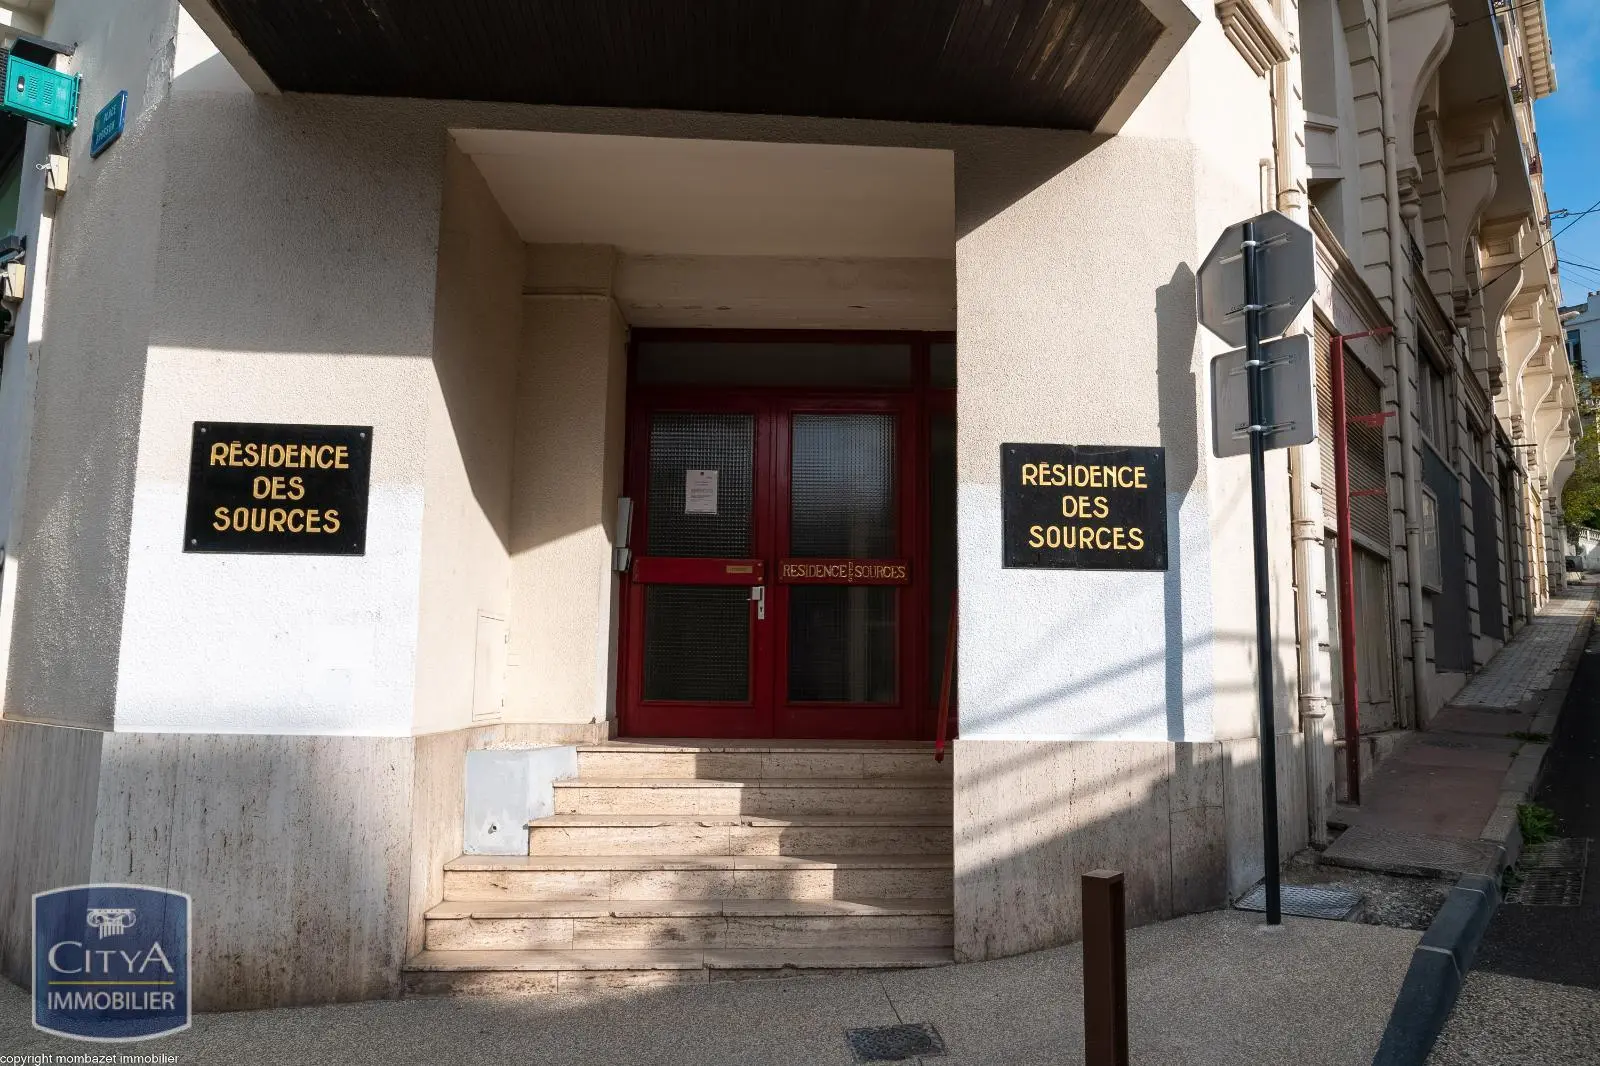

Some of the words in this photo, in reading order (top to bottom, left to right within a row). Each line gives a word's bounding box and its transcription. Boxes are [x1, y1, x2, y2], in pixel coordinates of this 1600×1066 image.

[209, 440, 350, 469] RÉSIDENCE
[252, 475, 306, 501] DES
[1021, 461, 1148, 489] RÉSIDENCE
[212, 506, 341, 534] SOURCES
[1062, 495, 1109, 519] DES
[1028, 525, 1145, 551] SOURCES
[783, 564, 847, 578] RESIDENCE
[854, 565, 906, 579] SOURCES
